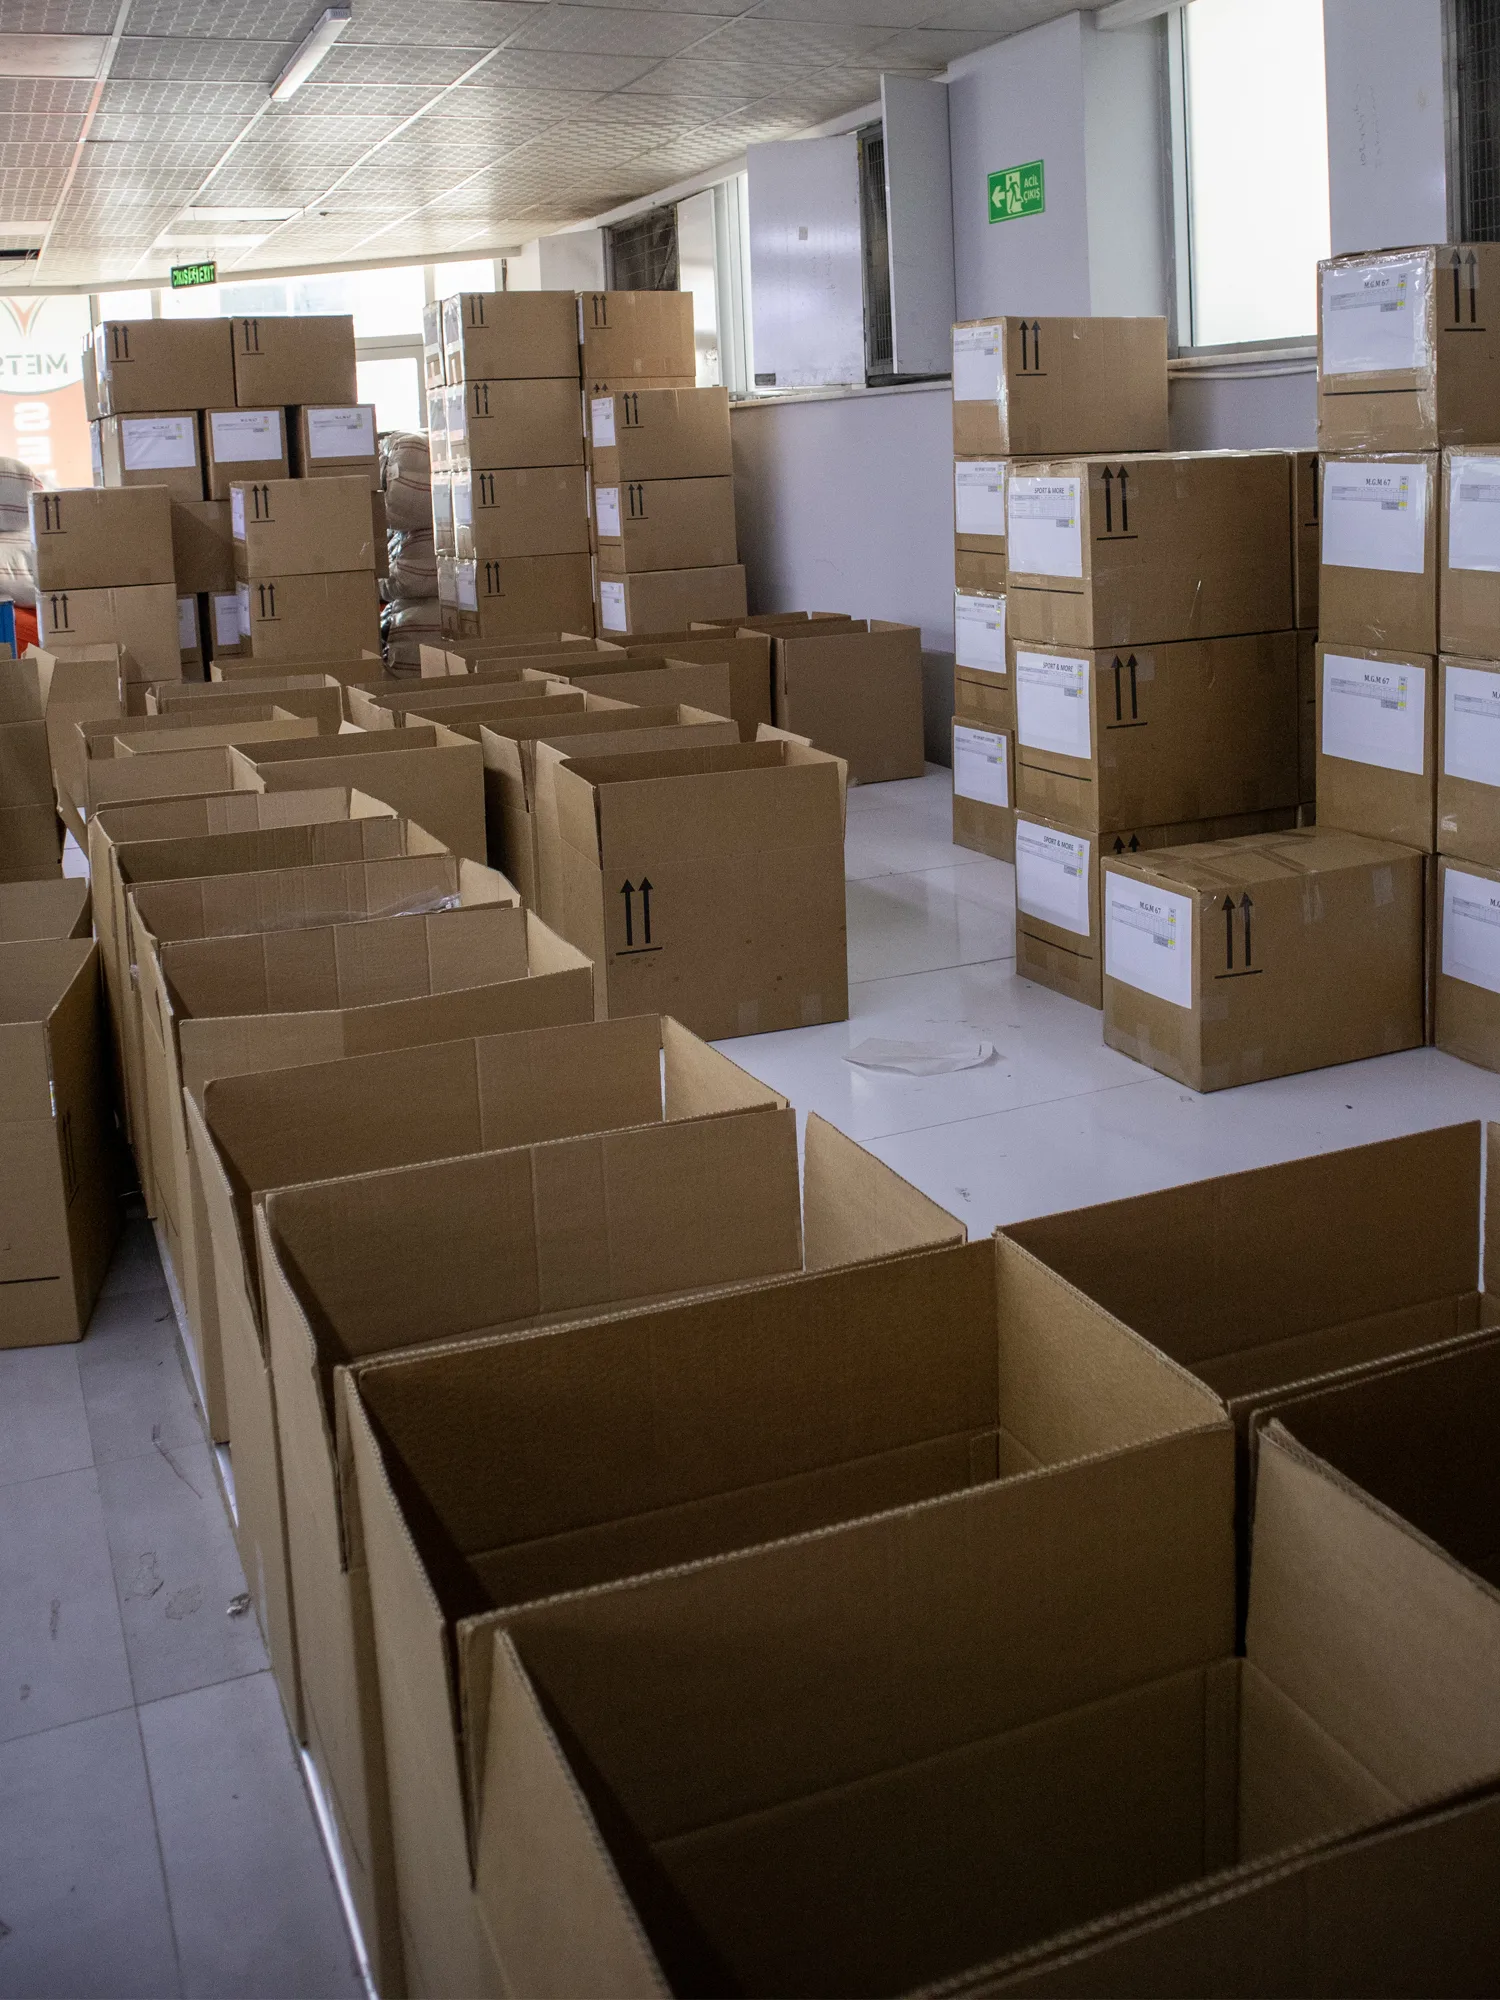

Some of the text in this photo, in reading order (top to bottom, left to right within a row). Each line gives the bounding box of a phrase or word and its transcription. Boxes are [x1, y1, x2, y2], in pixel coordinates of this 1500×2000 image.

[1024, 174, 1039, 188] ACİL
[1023, 187, 1041, 204] ÇIKIŞ
[199, 264, 214, 283] EXIT
[1381, 278, 1390, 287] 67
[1383, 478, 1391, 486] 67
[1034, 486, 1048, 494] SPORT
[1052, 487, 1065, 495] MORE
[1042, 661, 1056, 670] SPORT
[1060, 664, 1074, 673] MORE
[1382, 677, 1390, 685] 67
[1043, 835, 1057, 845] SPORT
[1061, 841, 1074, 851] MORE
